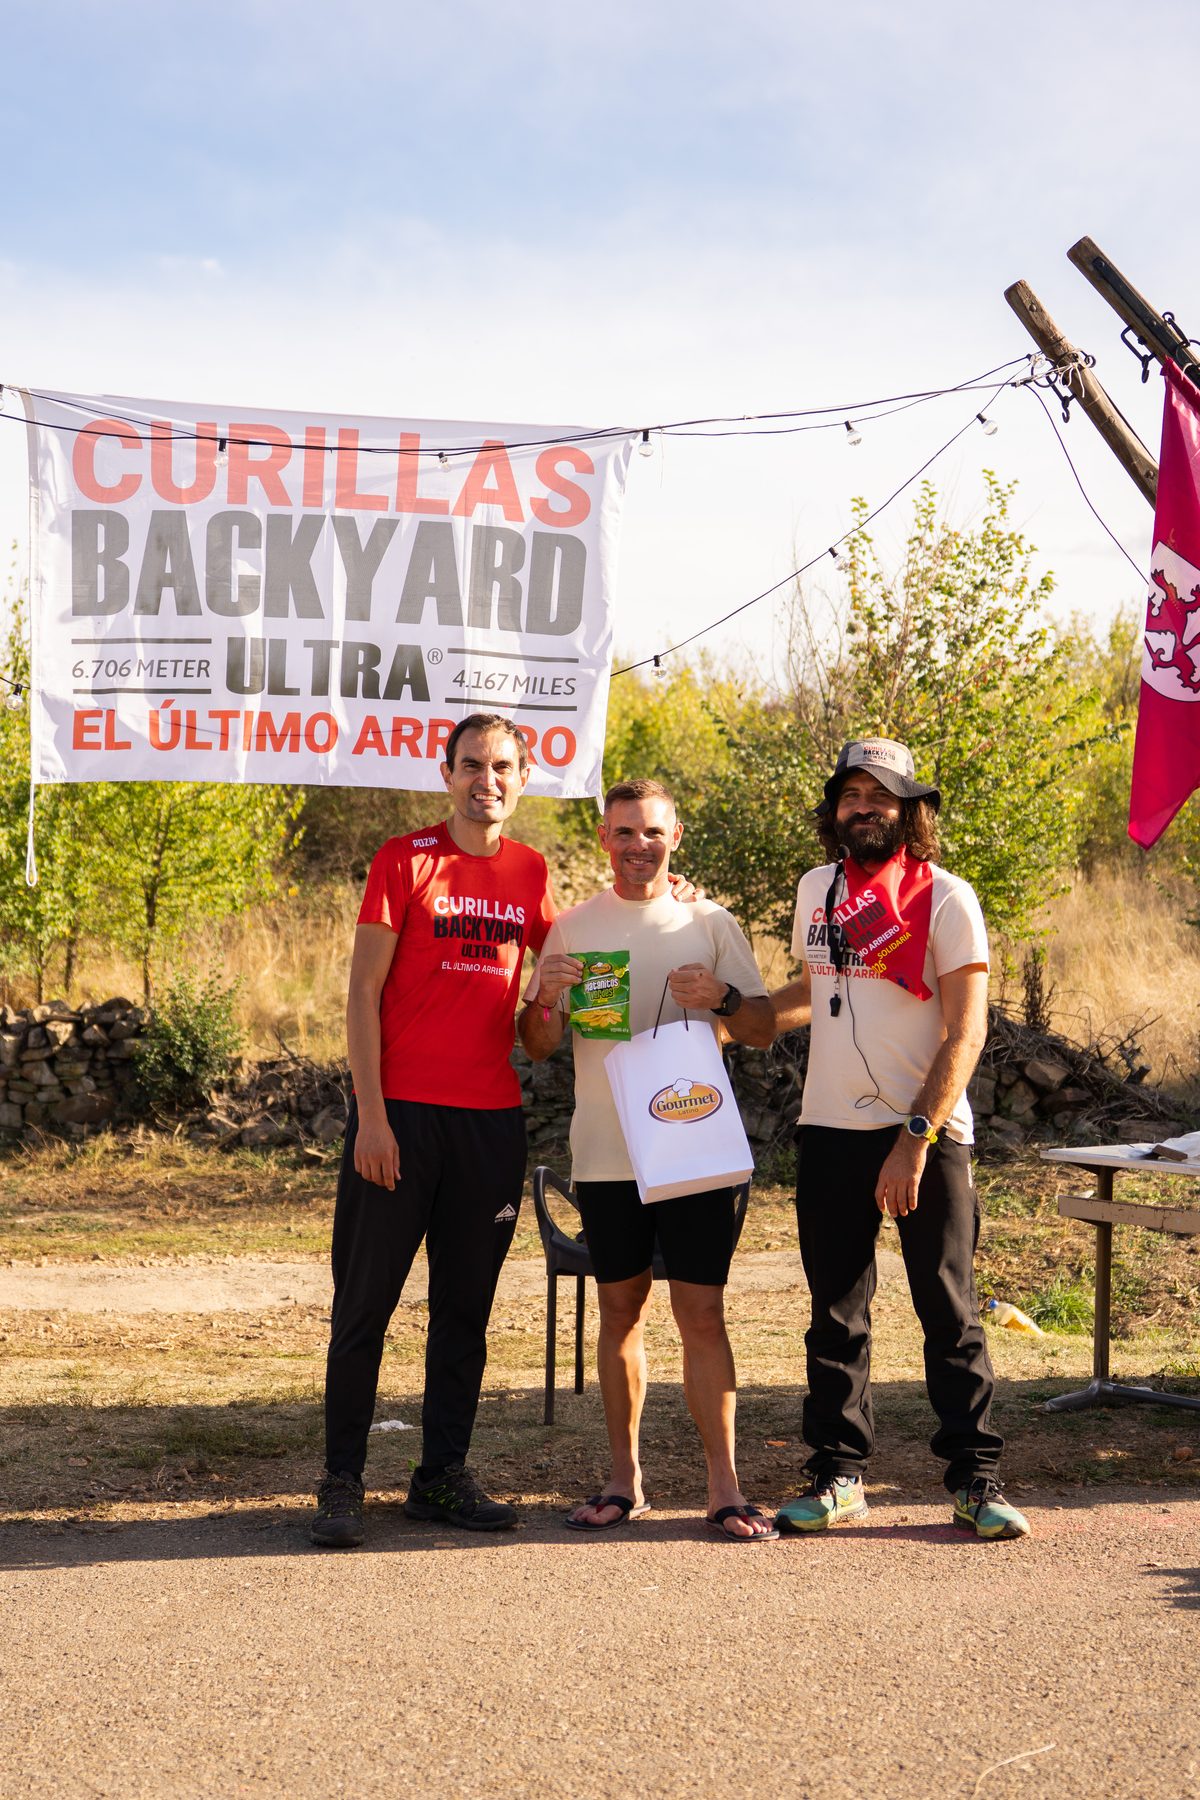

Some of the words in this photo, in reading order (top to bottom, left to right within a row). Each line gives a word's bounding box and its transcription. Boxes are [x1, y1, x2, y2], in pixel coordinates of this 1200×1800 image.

[72, 418, 595, 528] CURILLAS
[71, 509, 587, 636] BACKYARD
[72, 659, 132, 679] 6.706
[136, 658, 211, 678] METER
[452, 669, 509, 692] 4.167
[512, 675, 577, 696] MILES
[72, 709, 132, 751] EL
[148, 698, 339, 754] ÚLTIMO
[351, 714, 577, 768] ARRRO
[433, 896, 525, 925] CURILLAS
[834, 889, 877, 925] ILLAS
[433, 915, 524, 948] BACKYARD
[869, 924, 900, 951] ARRIERO
[461, 943, 498, 961] ULTRA
[877, 931, 912, 960] SOLIDARIA
[441, 961, 452, 970] EL
[871, 959, 887, 975] 026
[656, 1093, 715, 1112] Gourmet
[678, 1108, 699, 1116] Latino
